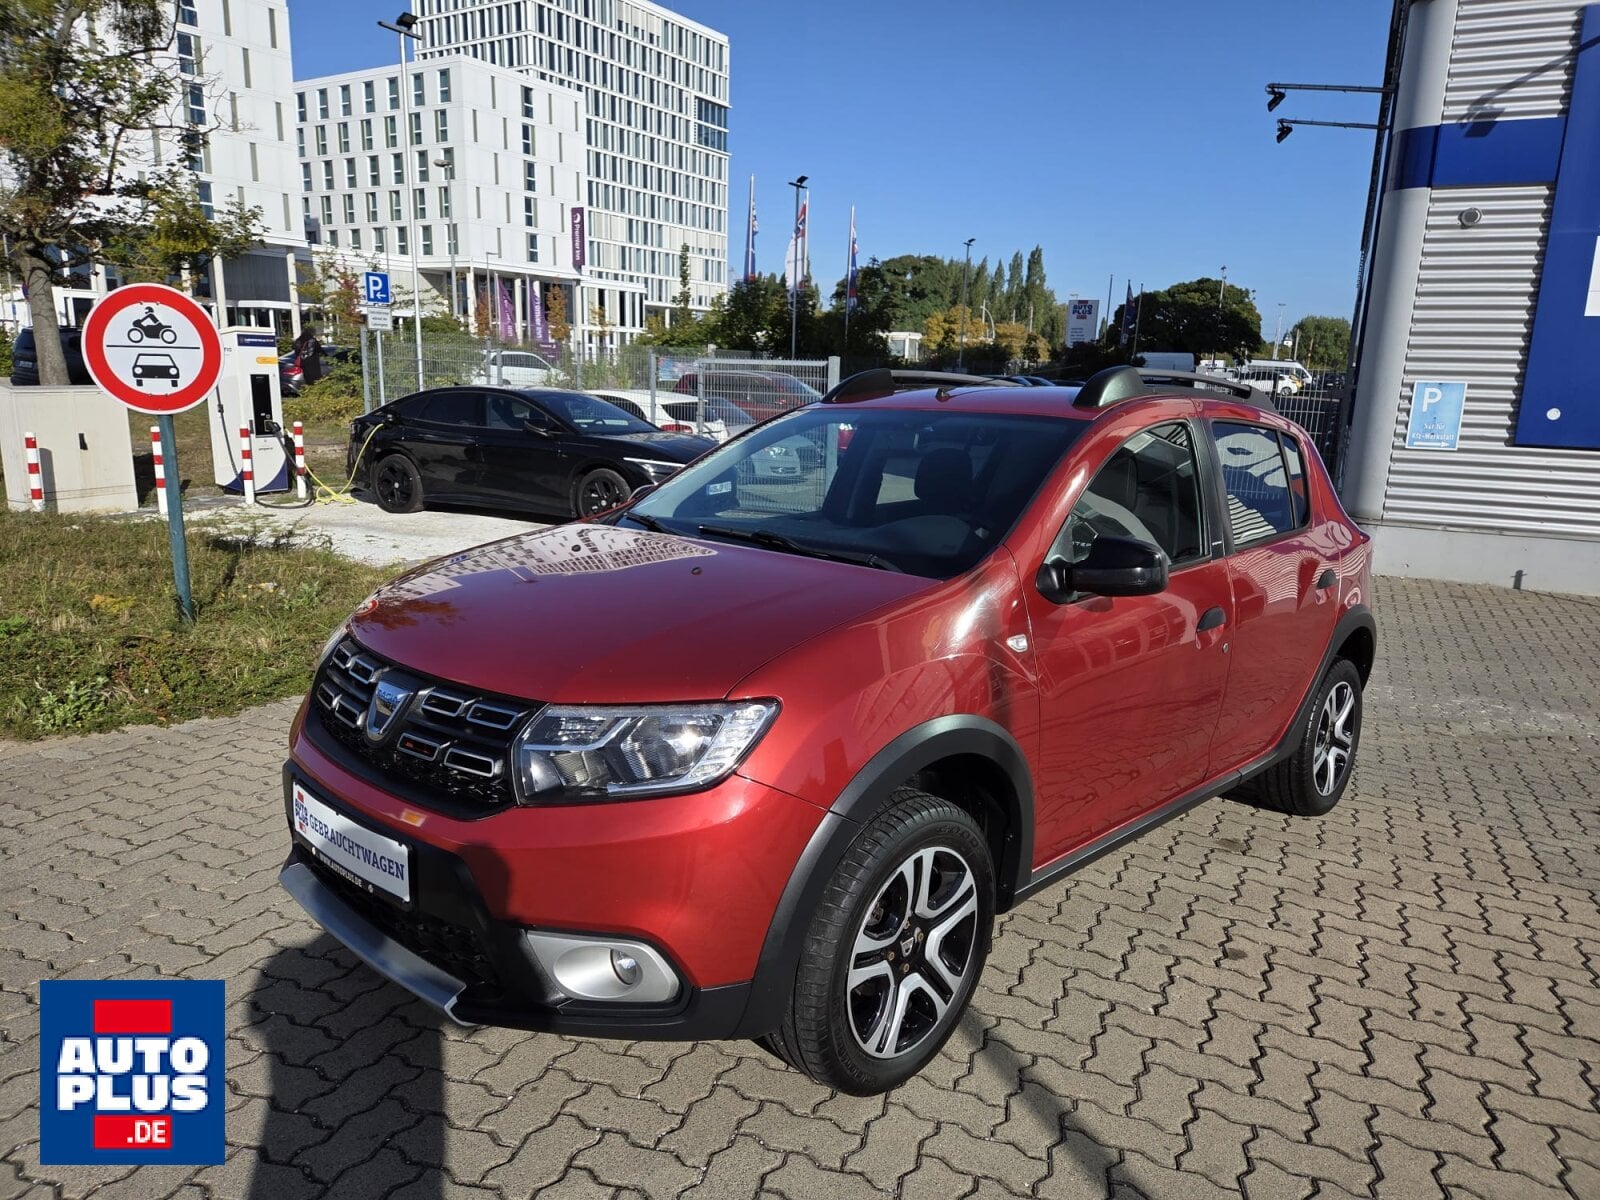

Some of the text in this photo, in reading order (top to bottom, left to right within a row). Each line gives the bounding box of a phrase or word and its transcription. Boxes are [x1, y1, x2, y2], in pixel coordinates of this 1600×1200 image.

[368, 275, 383, 299] P
[1422, 387, 1443, 413] P
[295, 798, 308, 817] AUTO
[295, 806, 309, 826] PLUS
[309, 812, 405, 881] GEBRAUCHTWAGEN
